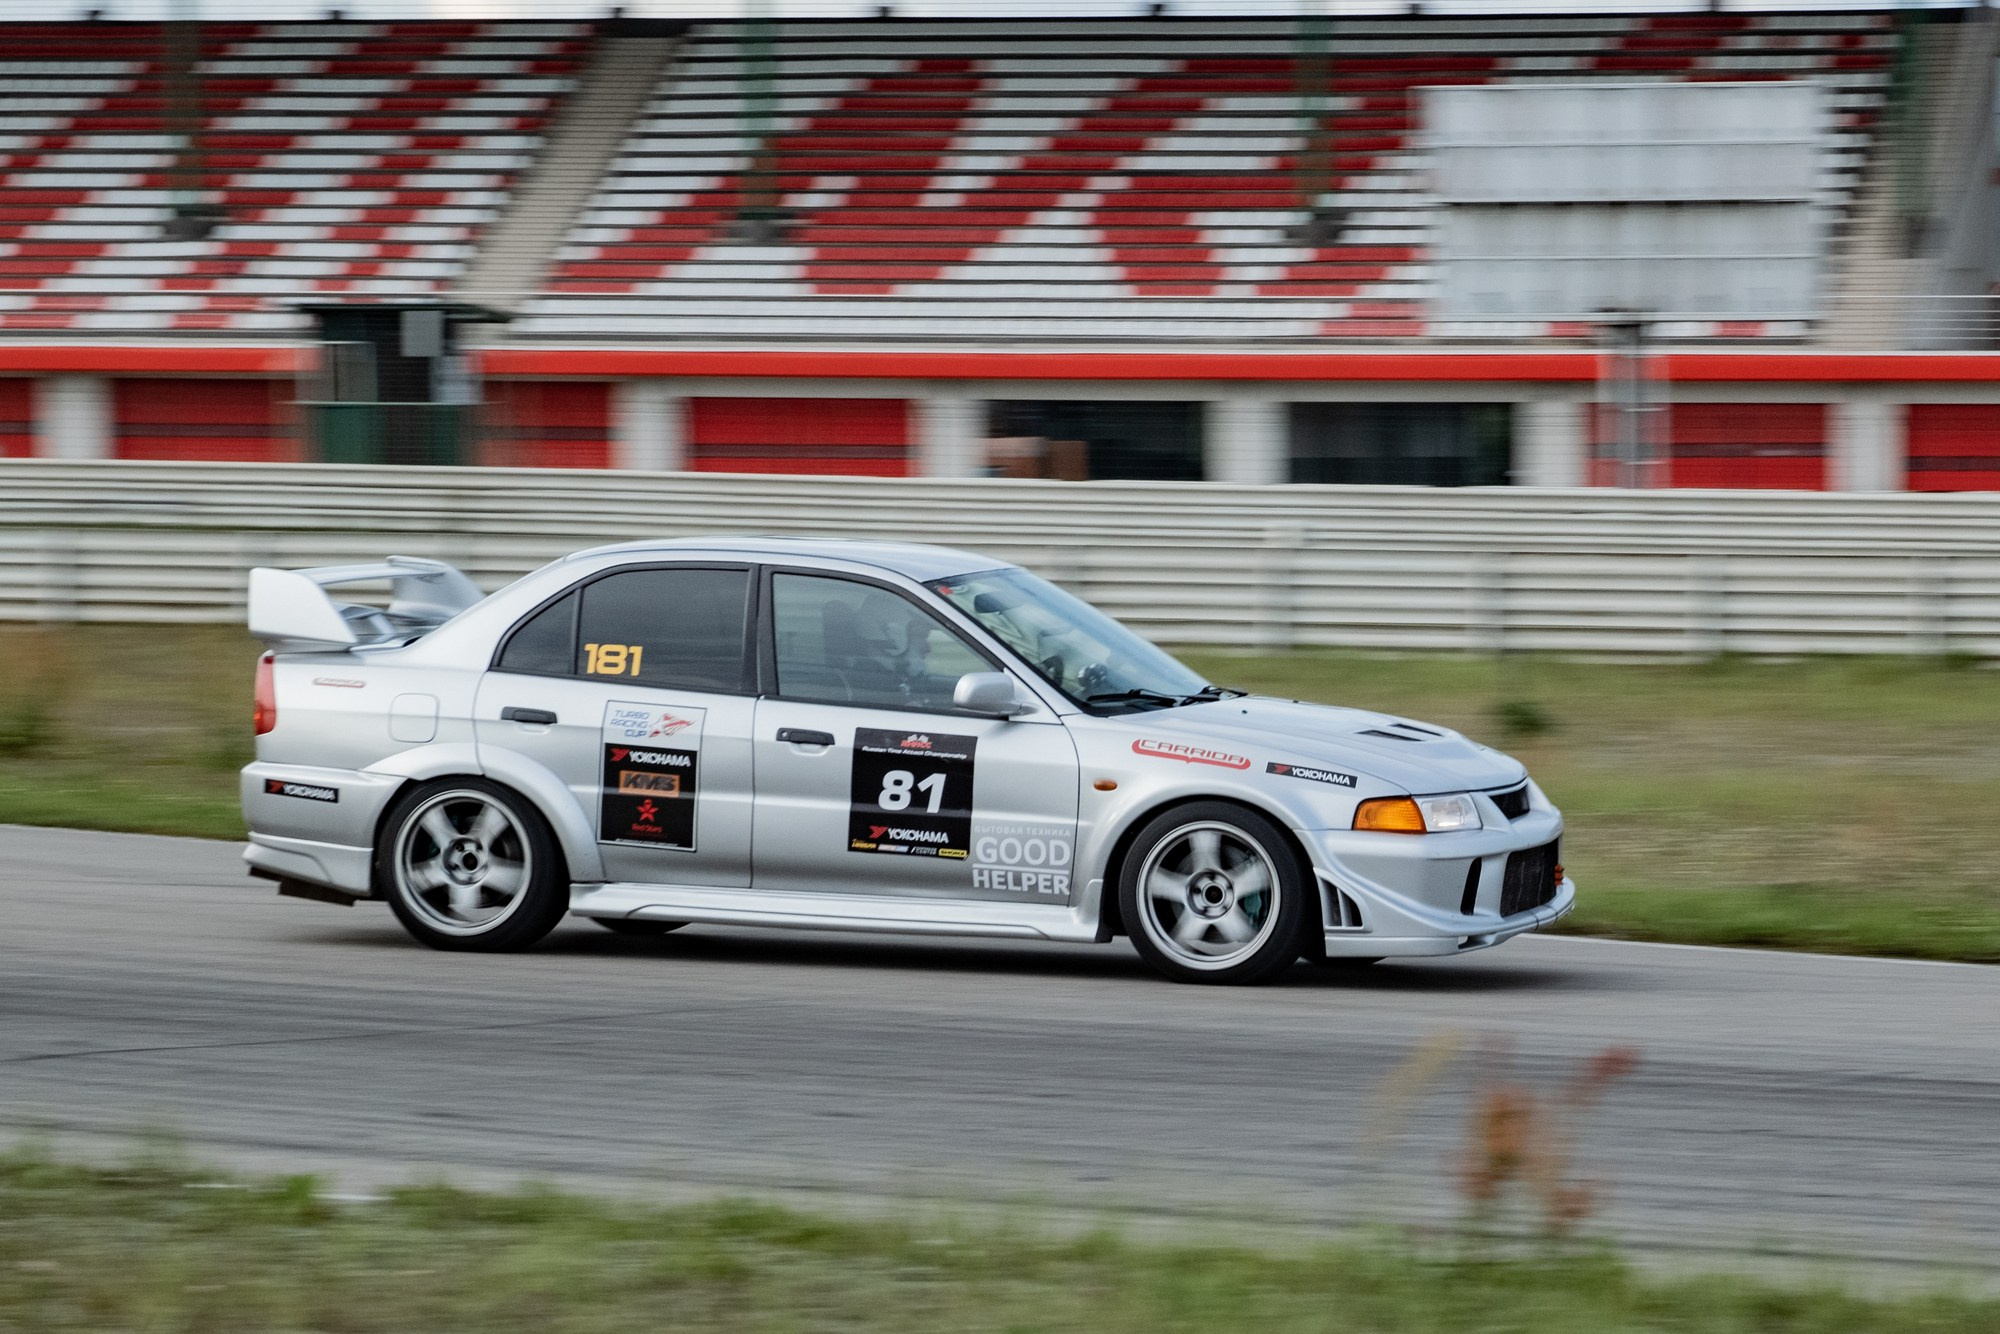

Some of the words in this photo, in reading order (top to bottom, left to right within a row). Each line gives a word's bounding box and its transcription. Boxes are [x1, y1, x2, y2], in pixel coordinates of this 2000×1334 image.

[584, 643, 643, 677] 181
[610, 719, 648, 728] RACING
[614, 710, 649, 720] TURBO
[624, 729, 647, 737] CUP
[629, 750, 692, 768] YOKOHAMA
[1139, 739, 1245, 765] CARRIDA
[1291, 766, 1351, 786] YOKOHAMA
[283, 783, 336, 800] YOKOHAMA
[878, 769, 947, 814] 81
[887, 827, 949, 844] YOKOHAMA
[974, 825, 1023, 836] БЫТОВАЯ
[1026, 826, 1072, 837] ТЕХНИКА
[975, 836, 1071, 866] GOOD
[972, 868, 1071, 895] HELPER
